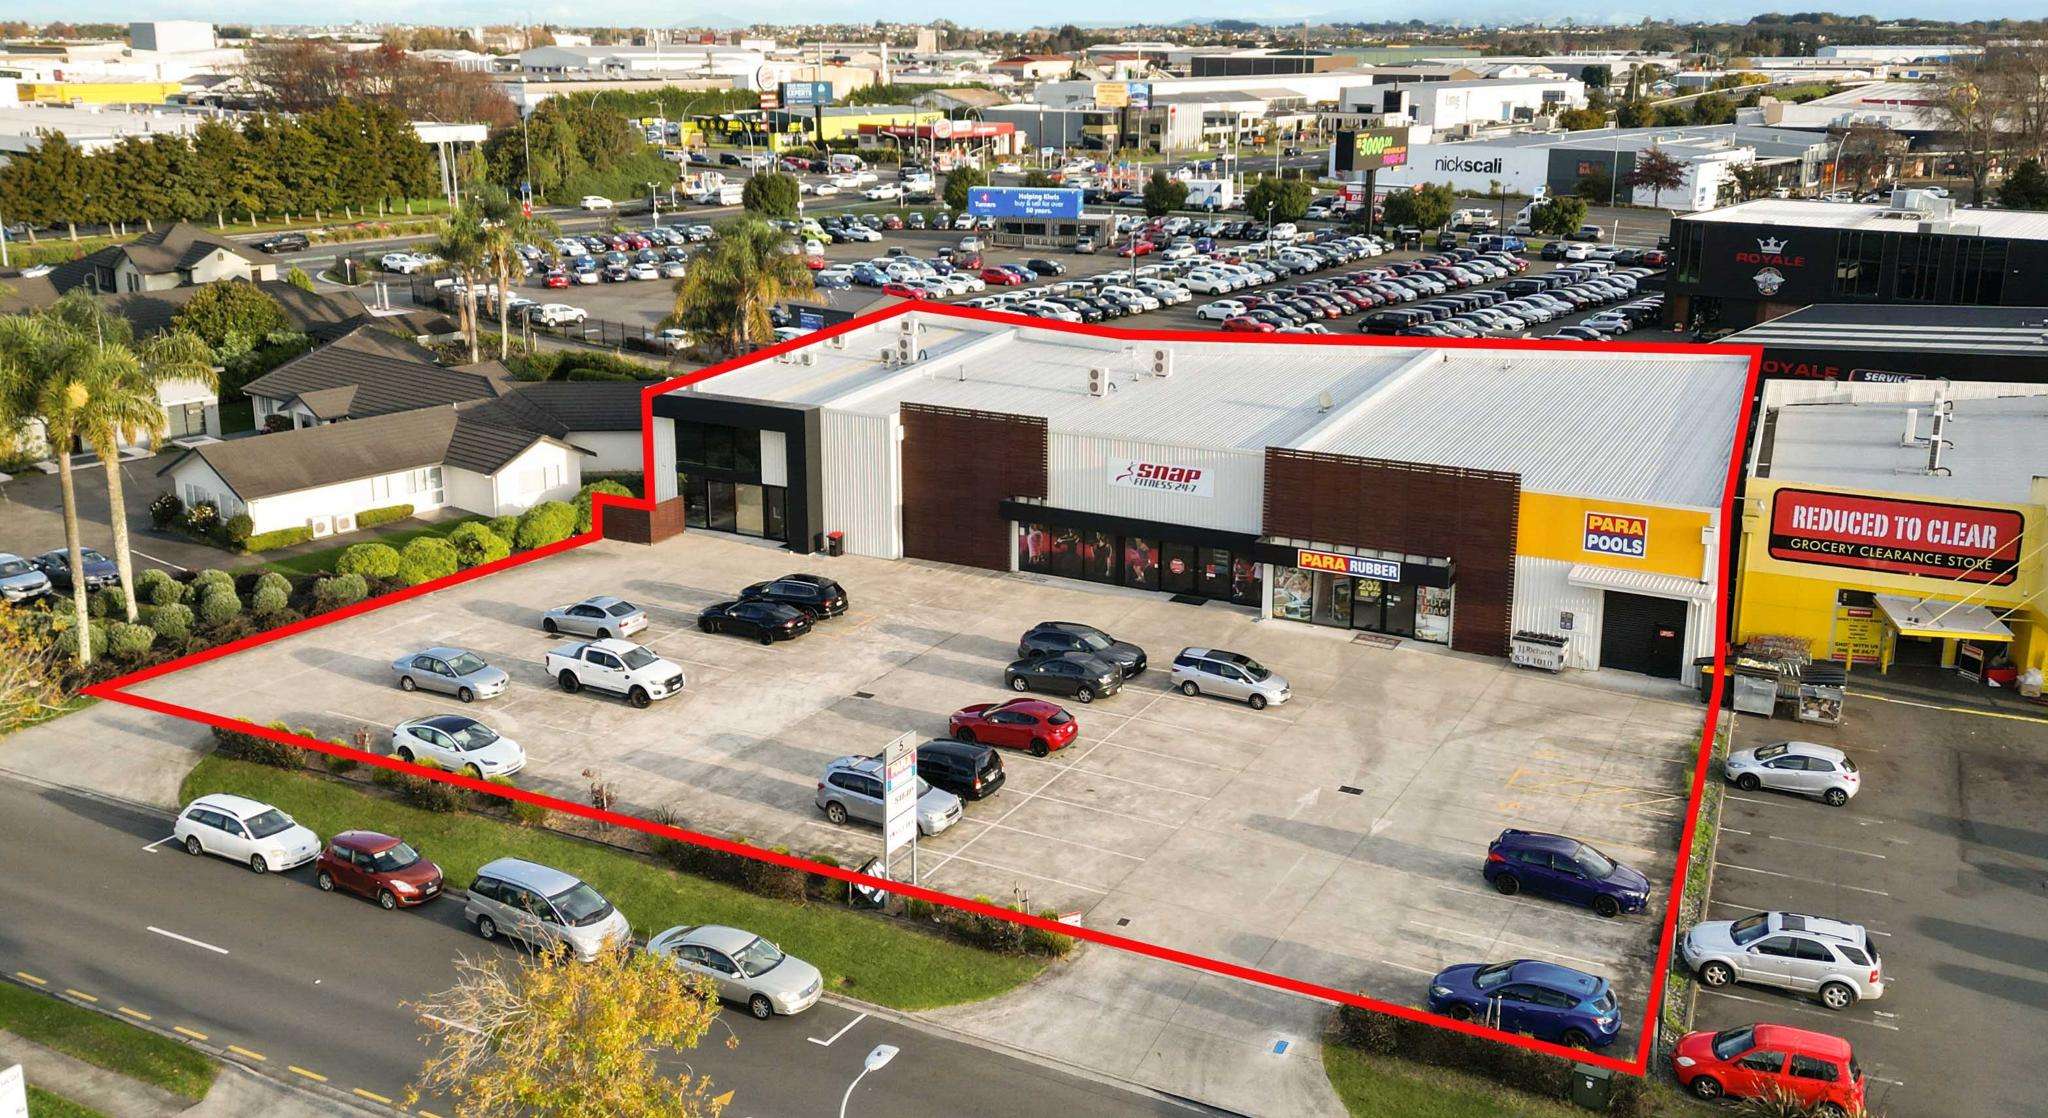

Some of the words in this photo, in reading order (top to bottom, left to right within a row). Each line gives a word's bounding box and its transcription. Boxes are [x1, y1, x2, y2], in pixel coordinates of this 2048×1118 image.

[1435, 156, 1502, 174] nickscali
[1019, 193, 1042, 201] Helping
[1736, 252, 1806, 267] ROYALE
[1763, 361, 1840, 378] OYALE
[1134, 478, 1172, 490] FITNESS
[1589, 515, 1643, 535] PARA
[1792, 505, 1889, 538] REDUCED
[1894, 516, 1922, 542] TO
[1926, 519, 1997, 550] CLEAR
[1587, 534, 1642, 554] POOLS
[1790, 538, 1855, 555] GROCERY
[1859, 546, 1942, 565] CLEARANCE
[1948, 556, 1993, 571] STORE
[1301, 552, 1346, 571] PARA
[1349, 560, 1397, 578] RUBBER
